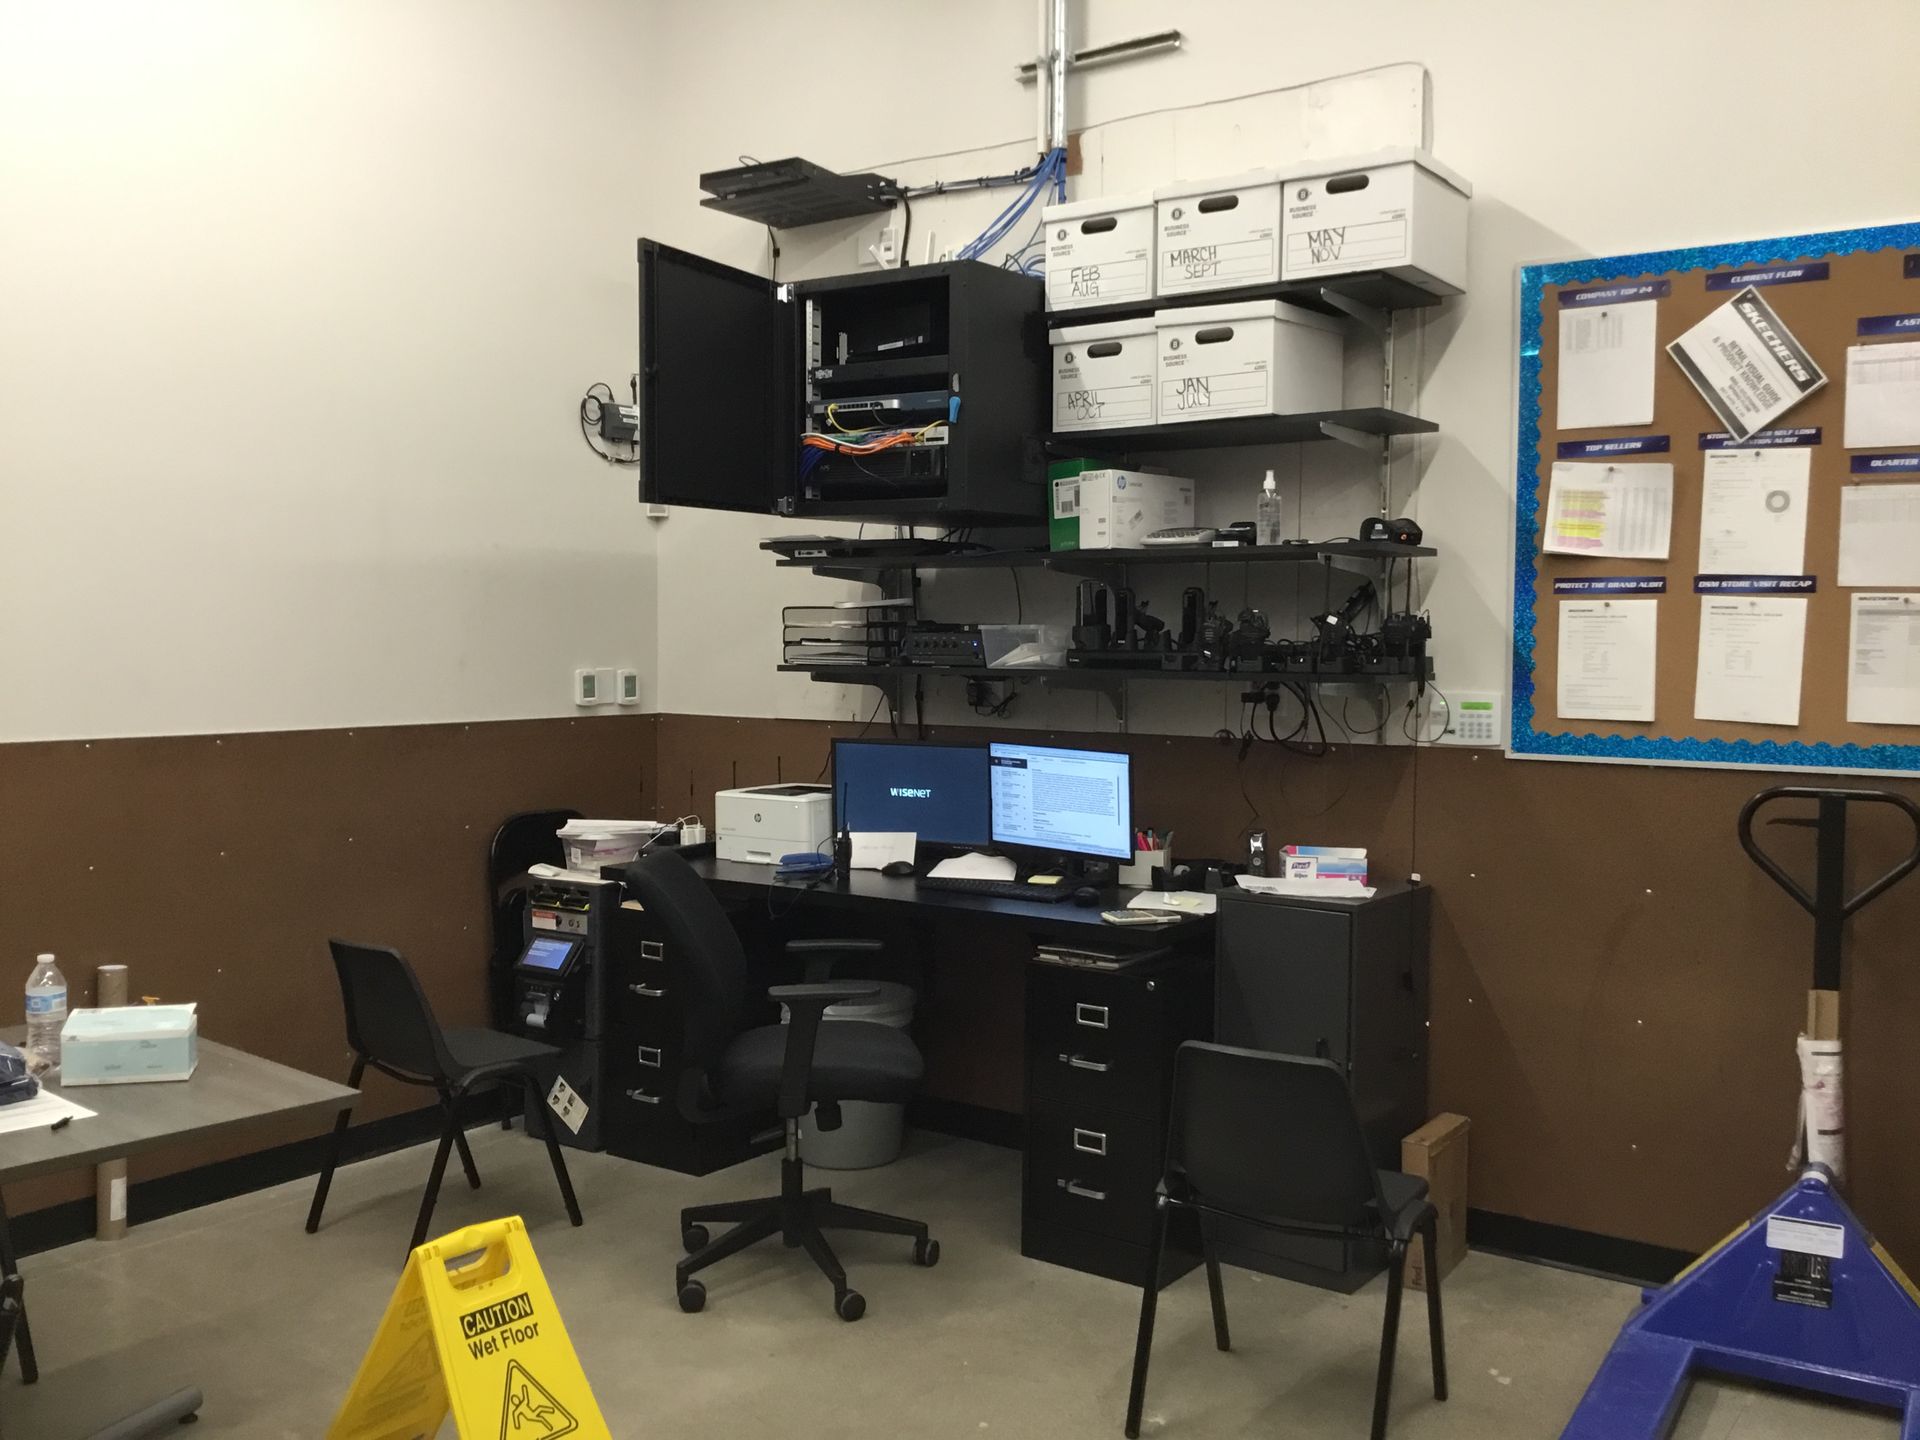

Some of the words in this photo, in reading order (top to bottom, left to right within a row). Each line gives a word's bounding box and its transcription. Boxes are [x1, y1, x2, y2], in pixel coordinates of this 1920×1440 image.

[1307, 226, 1345, 248] MAY
[1170, 245, 1217, 267] MARCH
[1311, 246, 1341, 264] NOV
[1071, 265, 1100, 283] FEB
[1185, 261, 1222, 280] SEPT
[1730, 272, 1775, 283] CURRENT
[1776, 270, 1804, 278] FLOW
[1072, 282, 1099, 297] AUG
[1576, 291, 1617, 300] COMPANY
[1738, 301, 1811, 383] SKECHERS
[1744, 360, 1765, 384] VISUAL
[1176, 376, 1210, 395] JAN
[1067, 391, 1105, 409] APRIL
[1177, 391, 1211, 410] JULY
[1077, 405, 1102, 420] OCT
[1604, 442, 1642, 450] SELLERS
[1870, 458, 1919, 467] QUARTER
[464, 1295, 531, 1336] CAUTION
[468, 1336, 500, 1360] Wet
[500, 1322, 538, 1349] Floor
